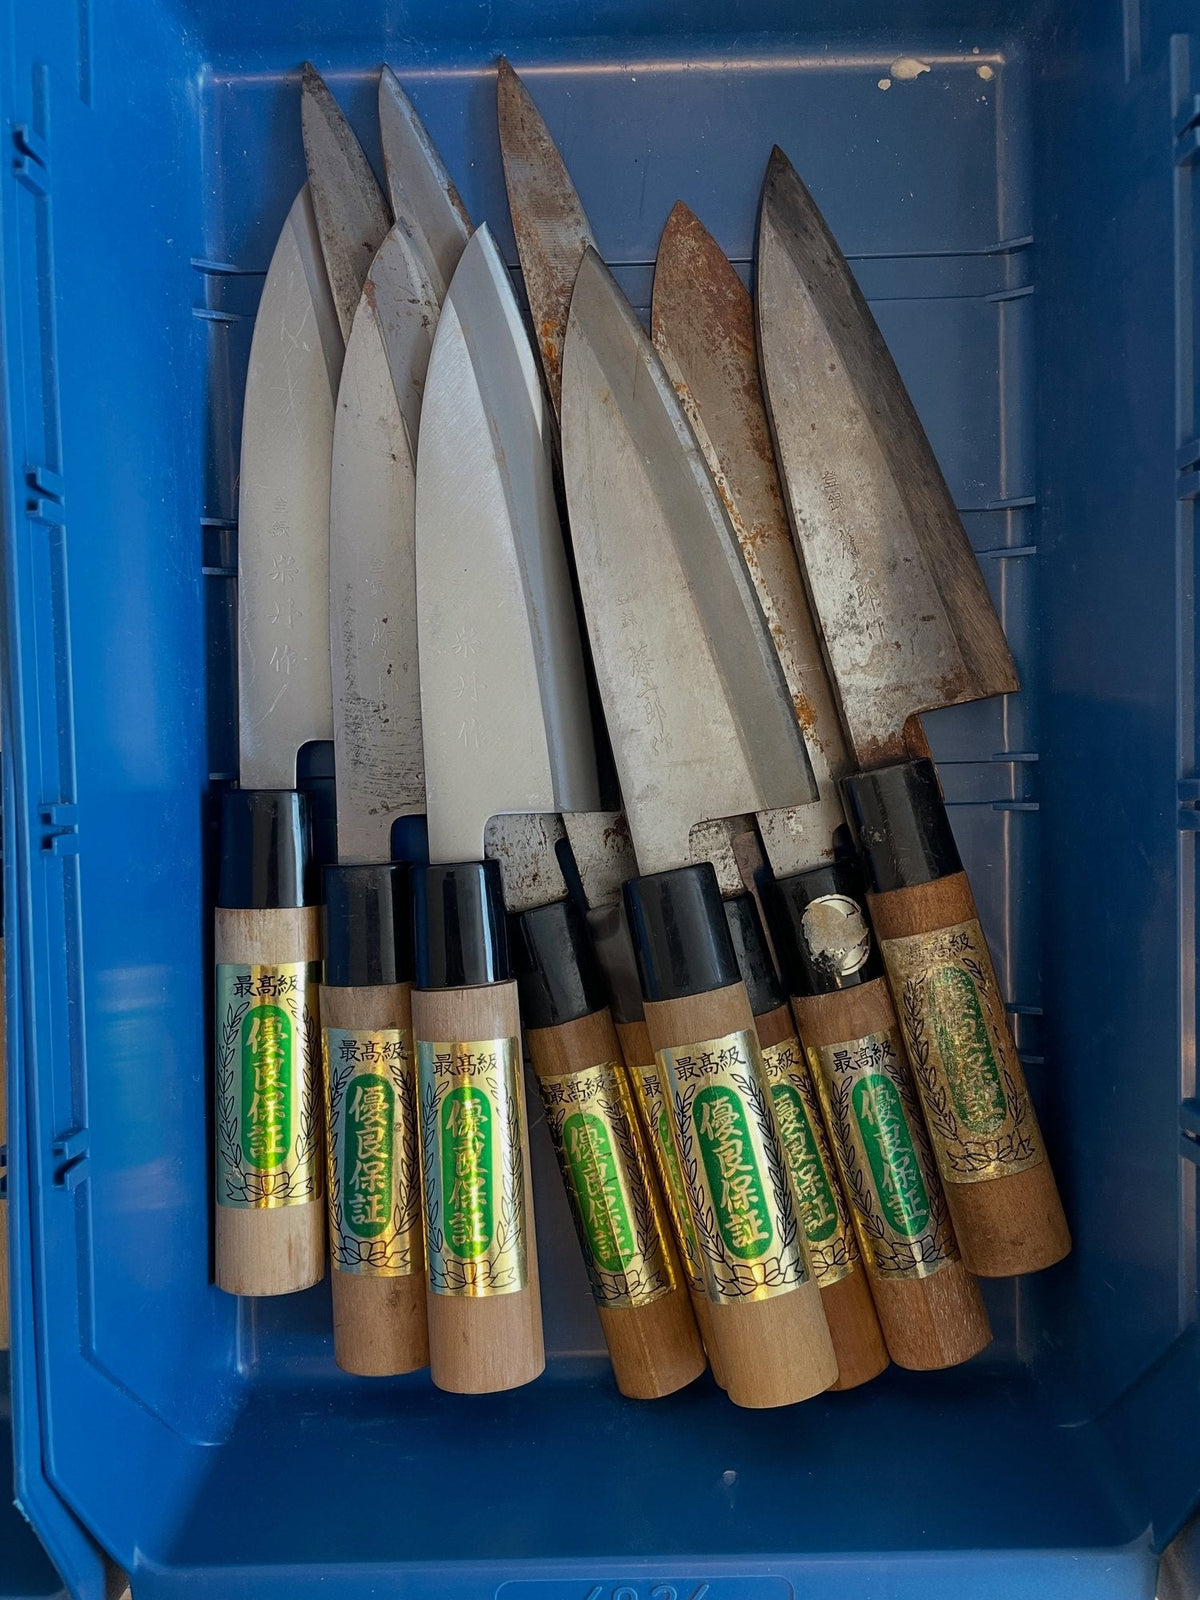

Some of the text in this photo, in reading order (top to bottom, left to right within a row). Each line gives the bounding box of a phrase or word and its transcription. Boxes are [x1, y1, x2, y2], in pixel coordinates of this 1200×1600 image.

[246, 1016, 289, 1158] 優良保証
[348, 1085, 389, 1225] 優良保証
[862, 1083, 928, 1225] 優良保証
[445, 1098, 489, 1247] 優良保証
[700, 1095, 770, 1248] 優良保証
